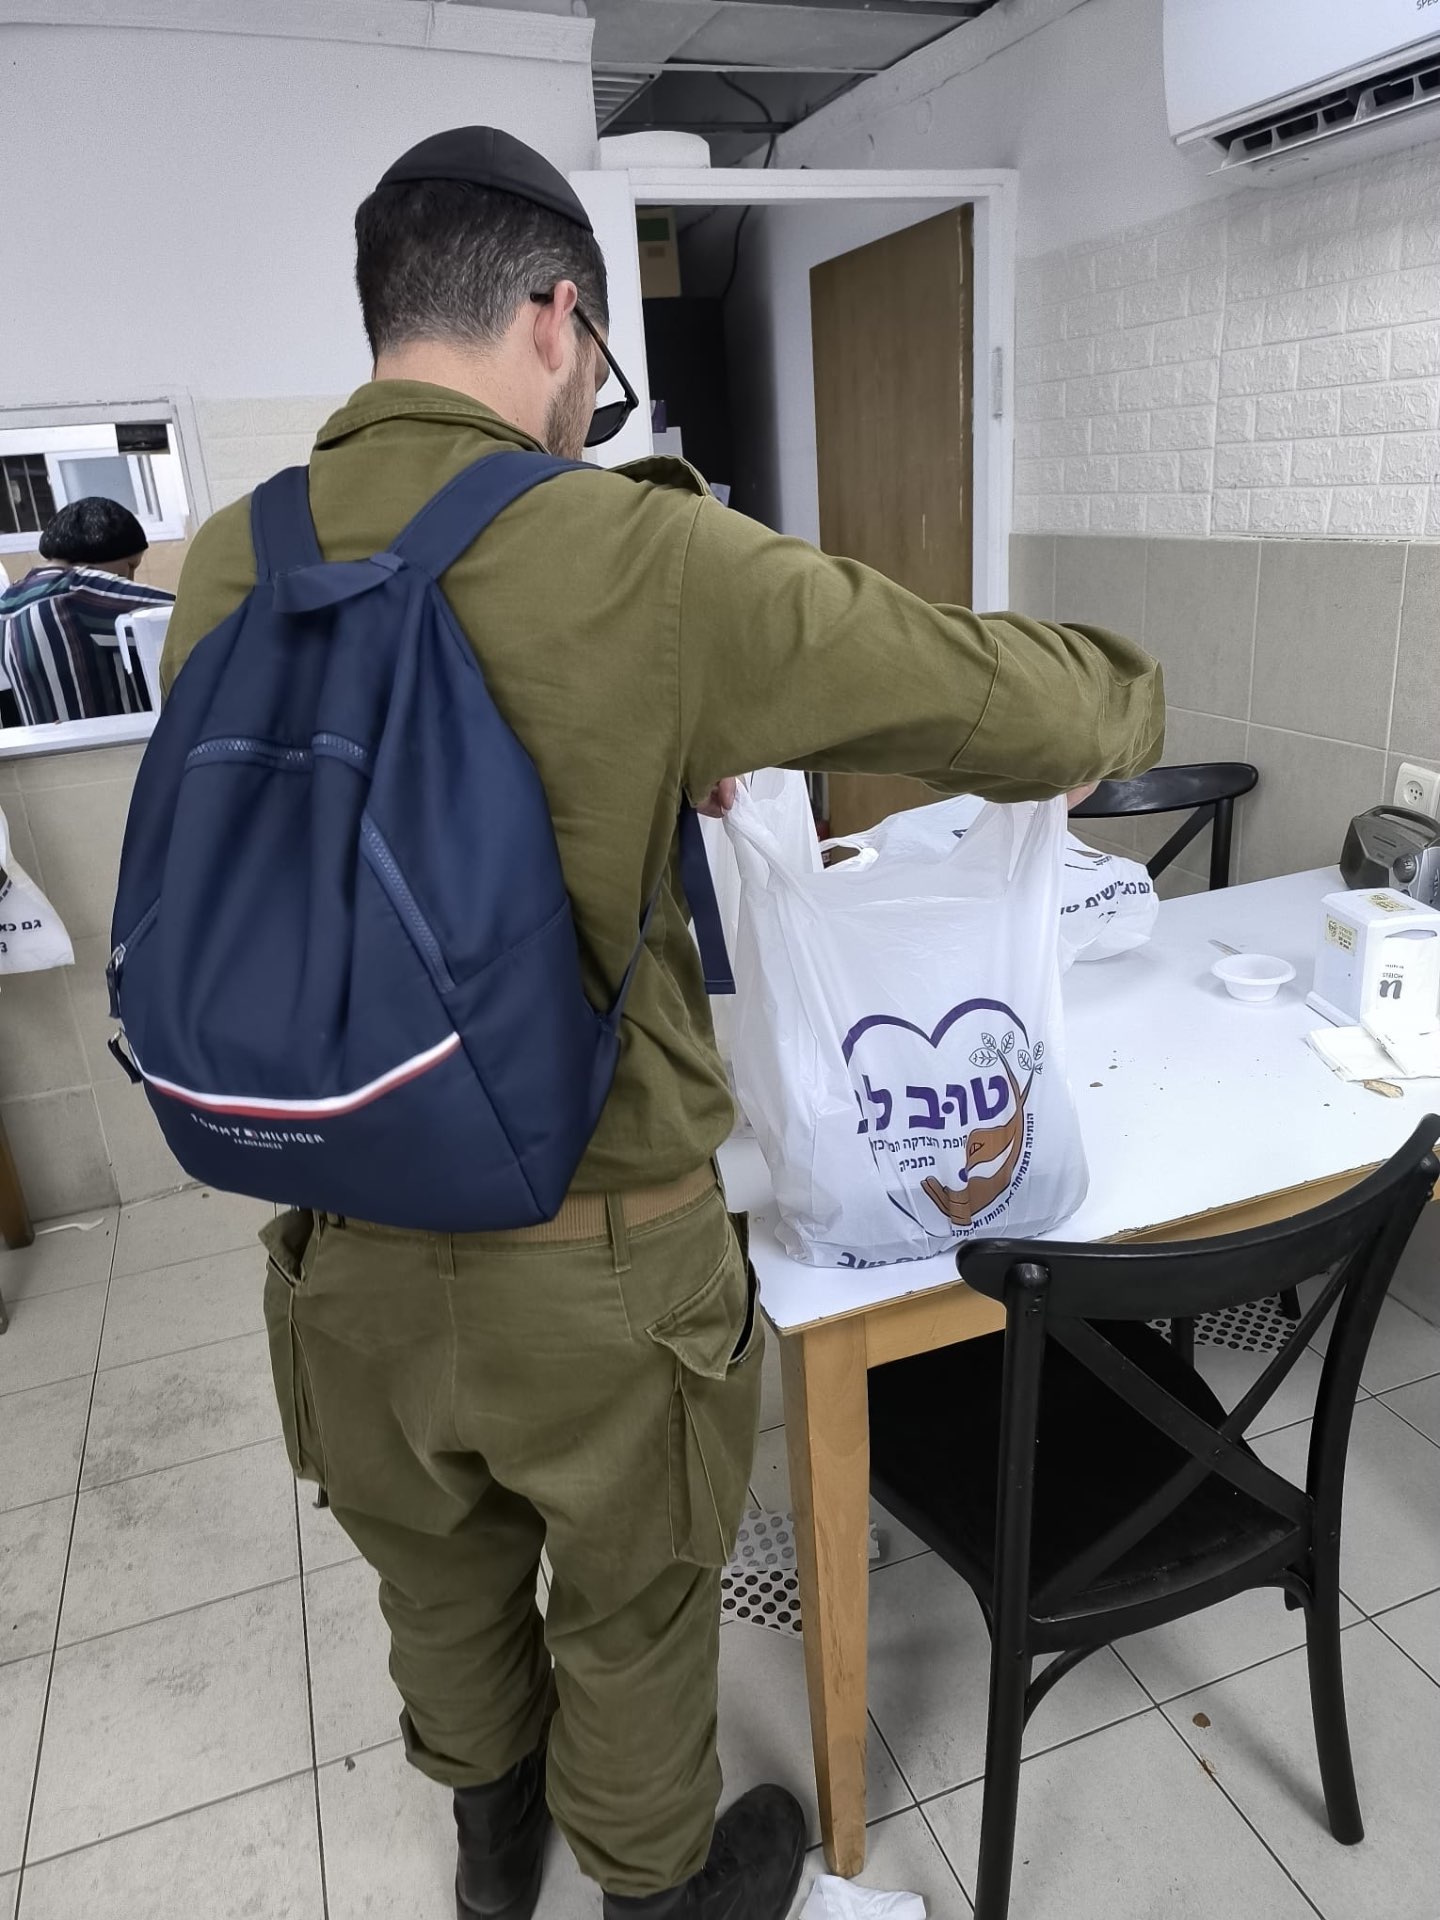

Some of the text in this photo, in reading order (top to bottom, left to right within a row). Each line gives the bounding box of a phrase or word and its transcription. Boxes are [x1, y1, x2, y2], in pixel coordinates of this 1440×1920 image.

[21, 919, 42, 931] גם
[906, 1075, 1010, 1130] טוב
[191, 1113, 326, 1145] TOMMY HILFIGER
[1025, 1112, 1035, 1149] הנתינה
[1011, 1150, 1032, 1191] מצמיחה
